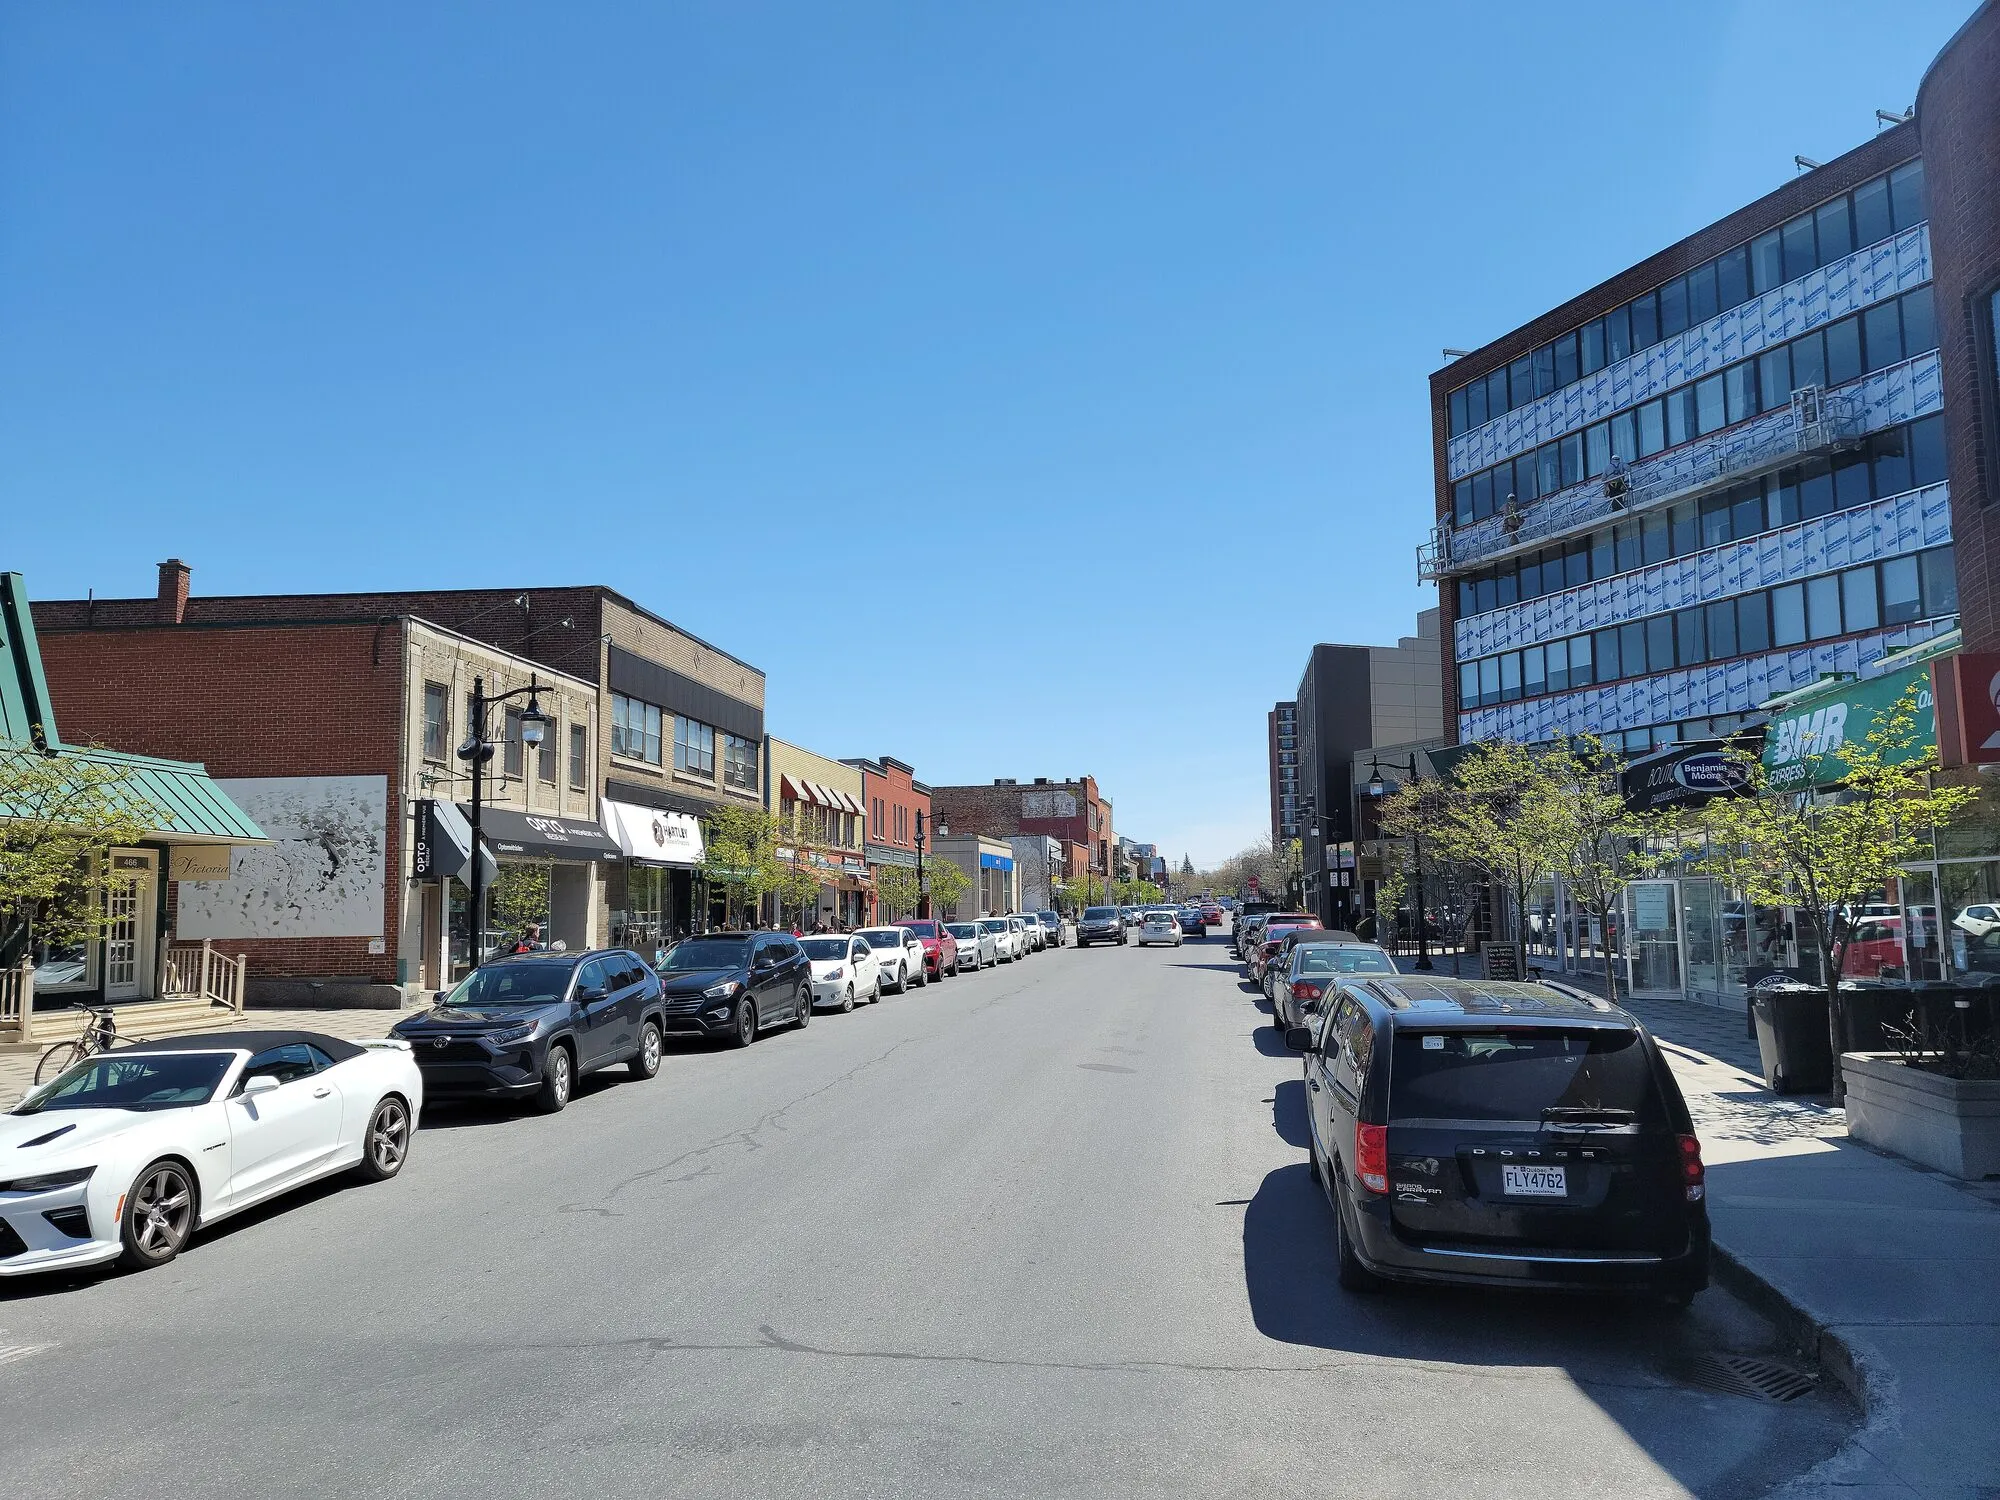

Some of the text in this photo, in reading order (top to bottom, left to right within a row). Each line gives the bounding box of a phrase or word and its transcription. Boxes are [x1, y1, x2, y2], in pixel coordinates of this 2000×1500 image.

[1773, 702, 1848, 765] BMR
[1684, 763, 1727, 774] Benjamin
[1691, 772, 1721, 780] Moore
[1769, 764, 1806, 786] EXPRESS
[525, 816, 565, 834] OPTO
[663, 825, 687, 839] HARTLEY
[123, 858, 138, 867] 466
[173, 855, 229, 875] Victoria
[417, 842, 426, 872] OPTO
[1473, 1148, 1595, 1158] DODGE
[1505, 1171, 1564, 1189] FLY4762
